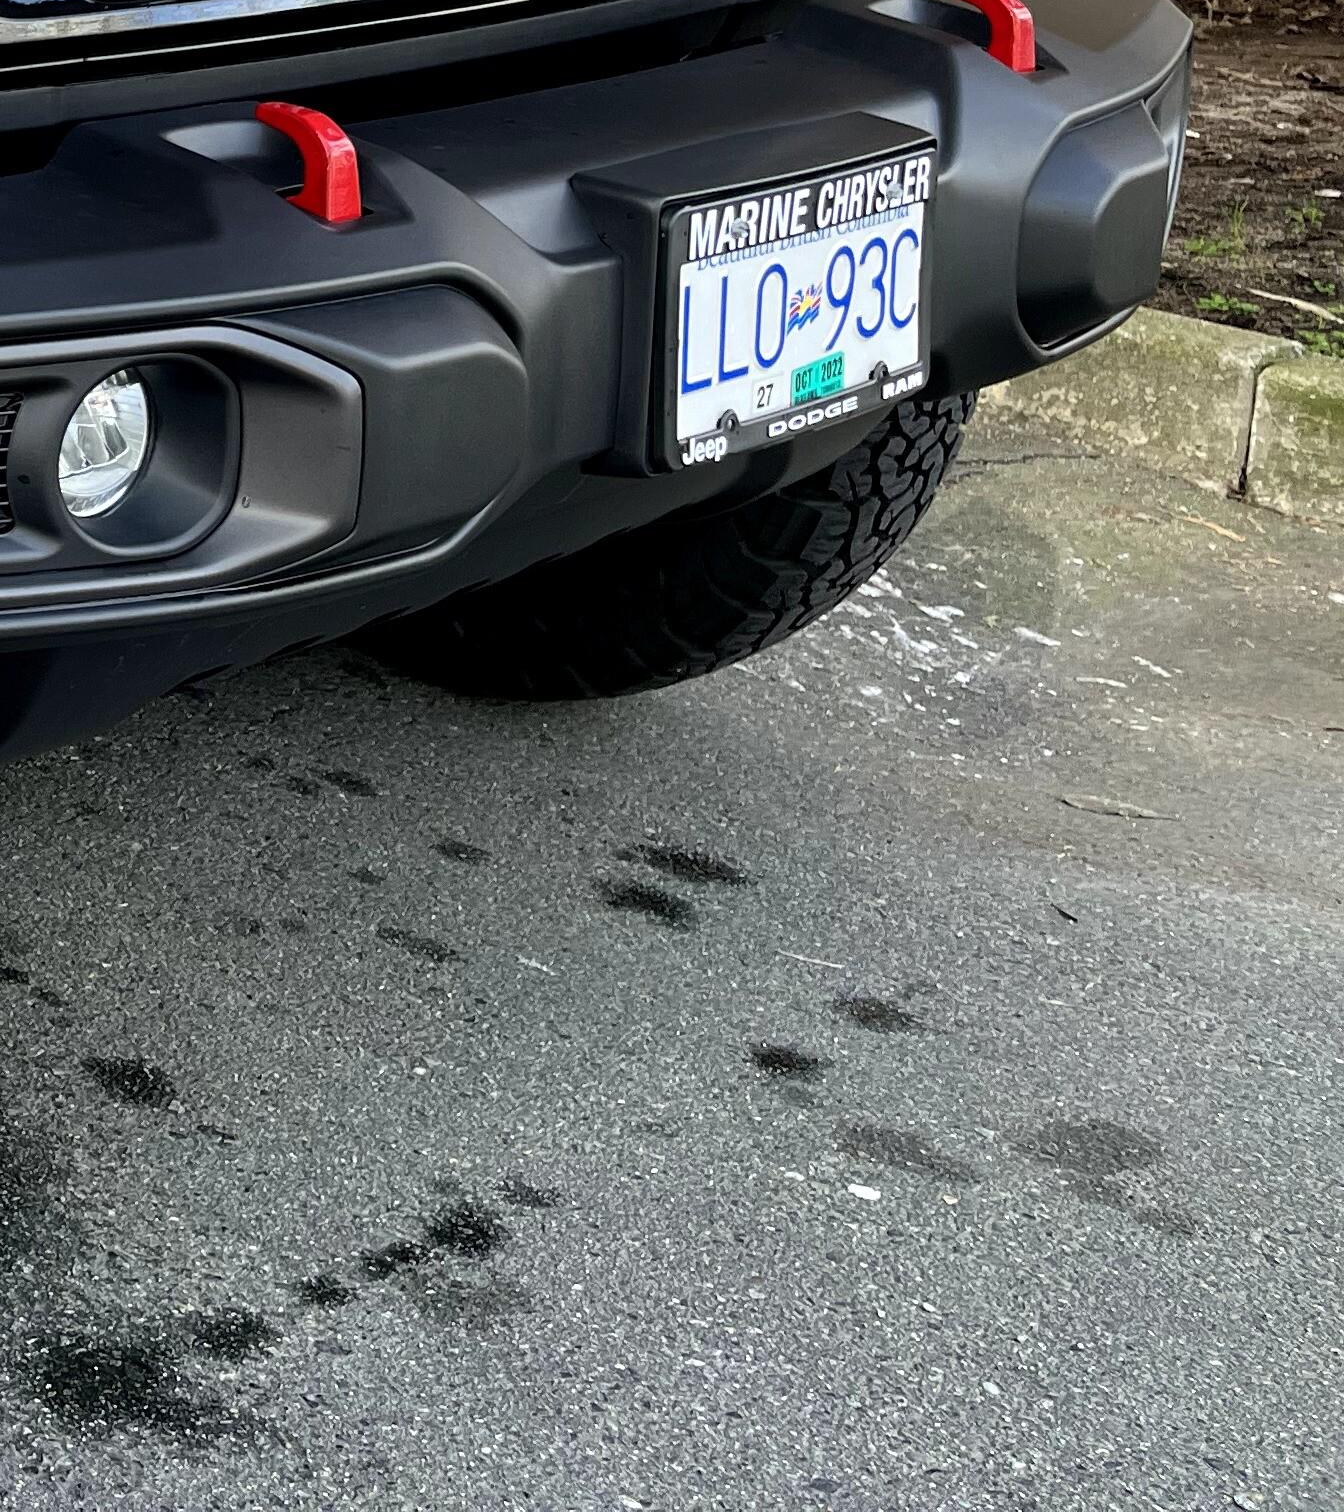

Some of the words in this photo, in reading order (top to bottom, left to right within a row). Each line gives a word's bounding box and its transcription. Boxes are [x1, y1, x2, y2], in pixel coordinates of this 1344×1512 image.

[688, 187, 810, 262] MARINE
[815, 155, 931, 230] CHRYSLER
[757, 383, 774, 409] 27
[795, 368, 813, 392] OCT
[820, 355, 844, 382] 2022
[682, 433, 728, 466] Jeep
[768, 395, 859, 438] DODGE
[881, 370, 924, 401] RAM
